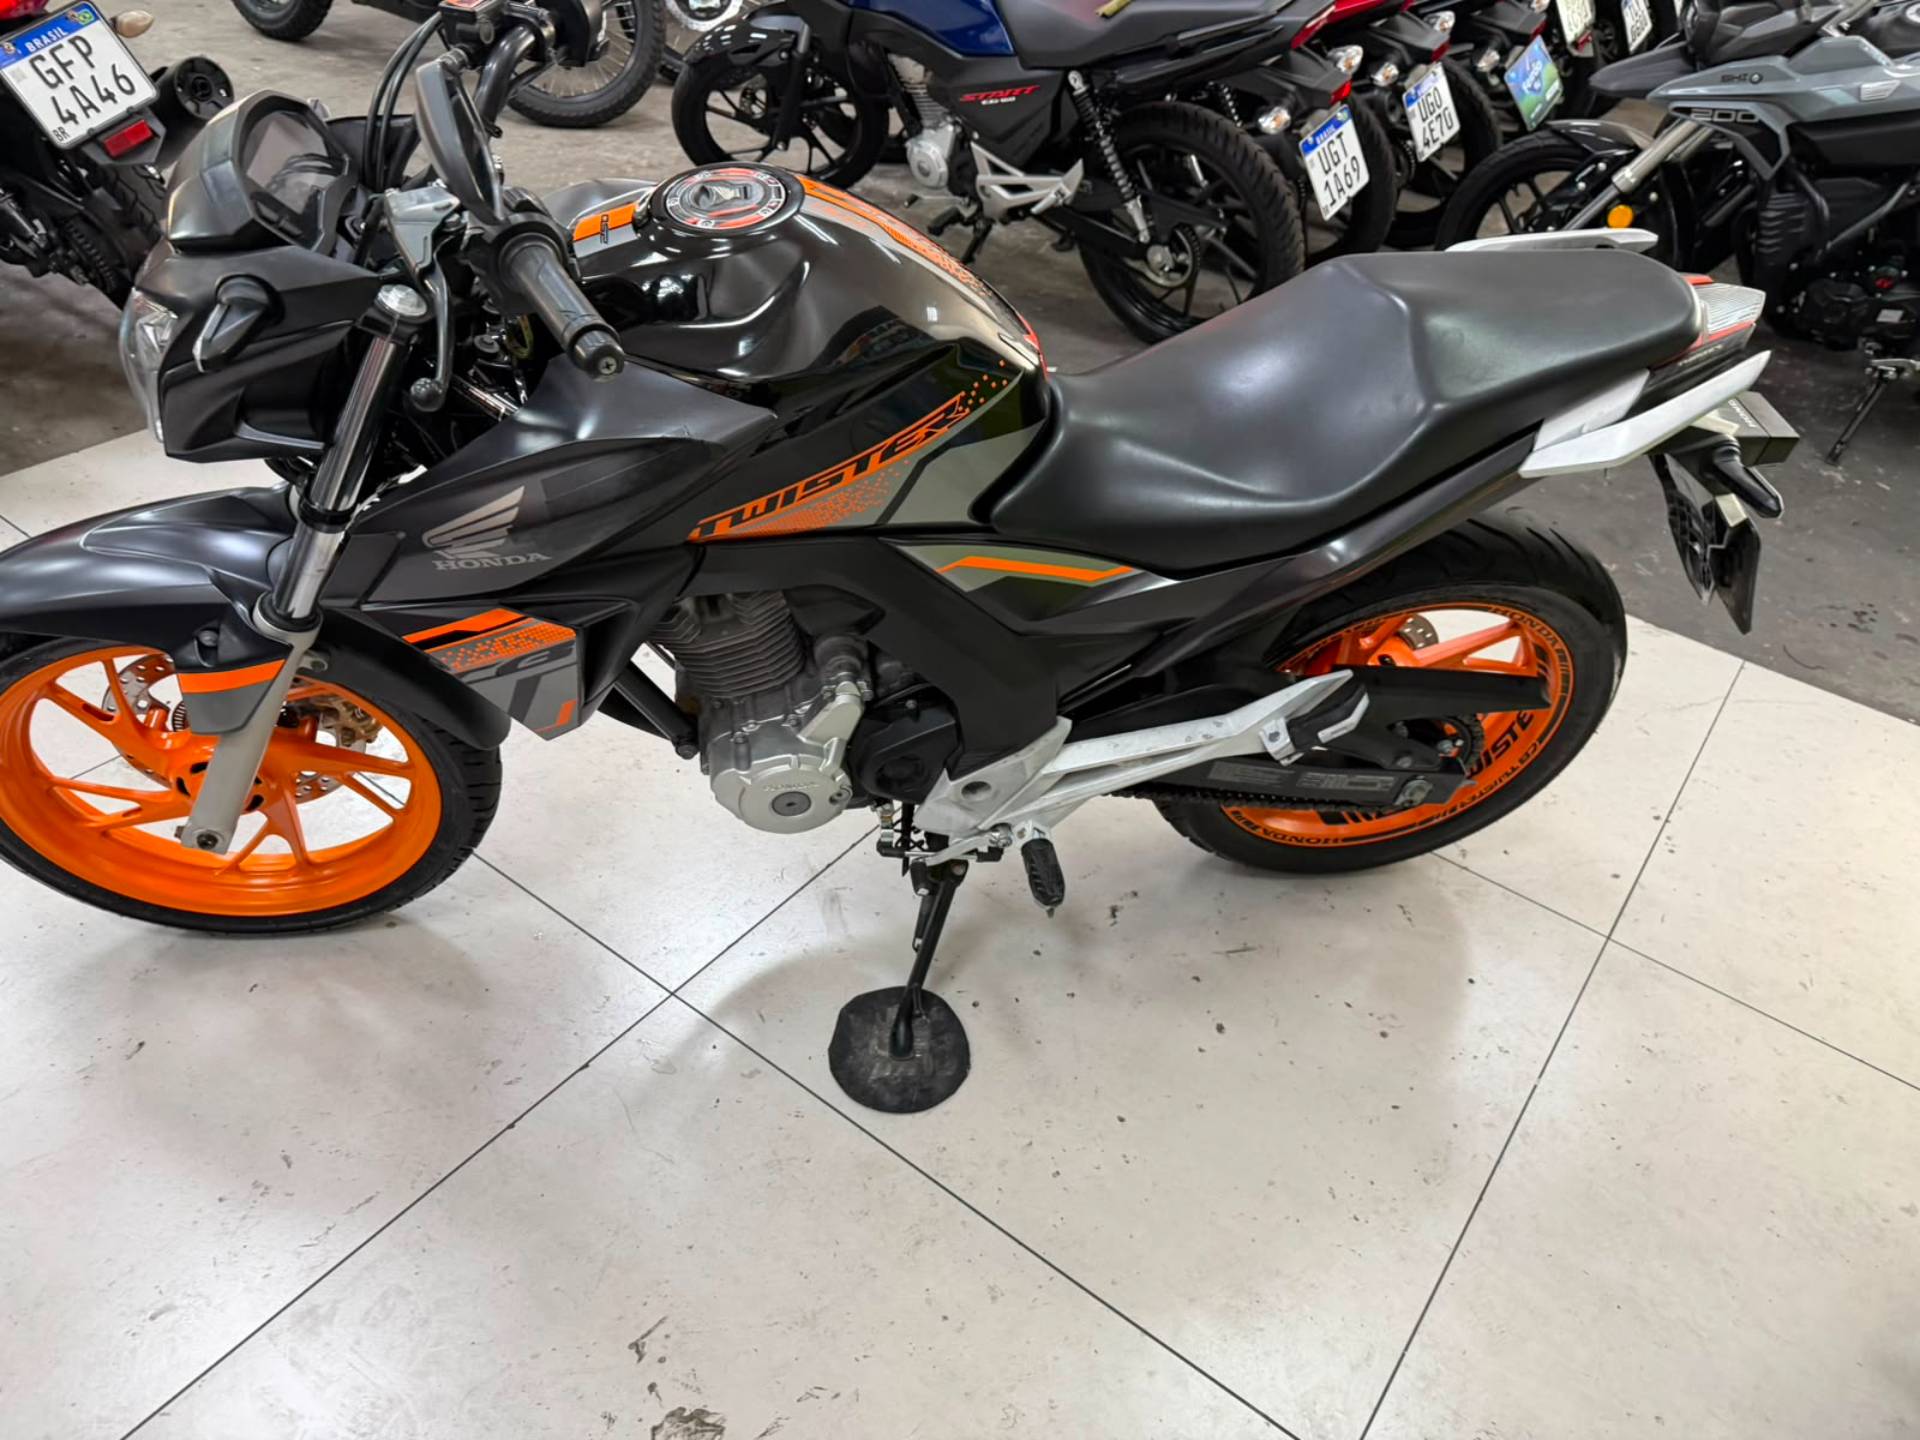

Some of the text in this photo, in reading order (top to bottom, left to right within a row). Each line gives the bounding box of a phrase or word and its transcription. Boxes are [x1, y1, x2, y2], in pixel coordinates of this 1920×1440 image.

[25, 26, 69, 52] BRASIL
[29, 35, 95, 89] GFP
[50, 64, 136, 125] 4A46
[1690, 108, 1759, 123] 200
[1317, 132, 1348, 175] UGT
[1324, 155, 1361, 206] 1A69
[432, 552, 552, 571] HONDA
[1488, 606, 1560, 647] HONDA
[1262, 828, 1344, 845] HONDA
